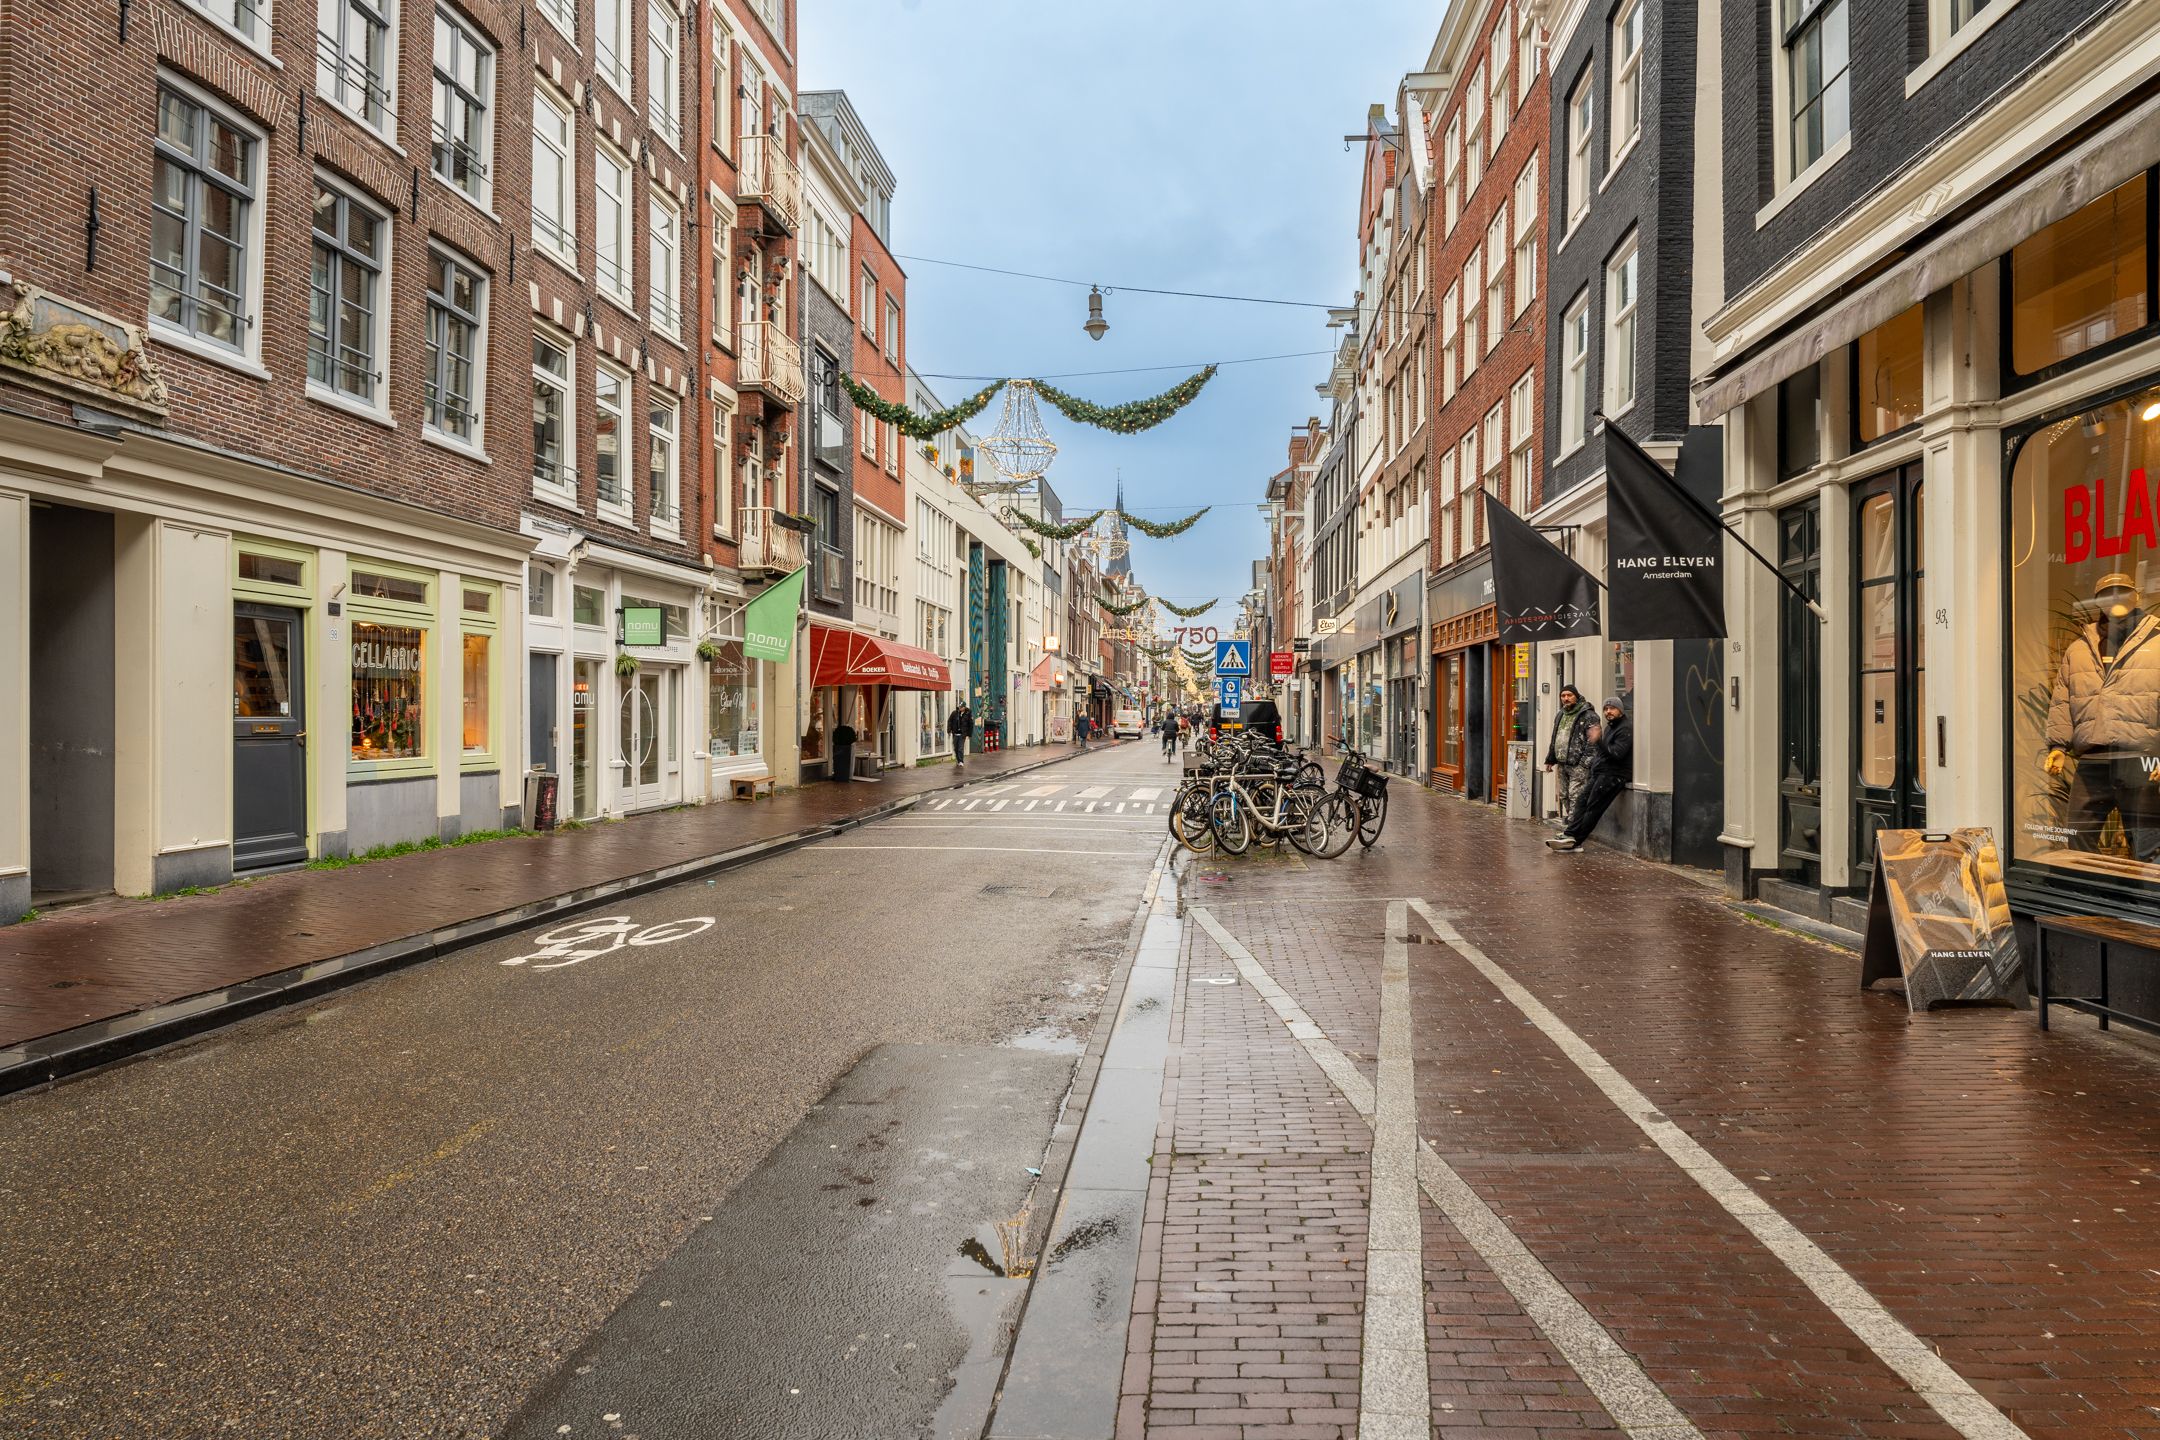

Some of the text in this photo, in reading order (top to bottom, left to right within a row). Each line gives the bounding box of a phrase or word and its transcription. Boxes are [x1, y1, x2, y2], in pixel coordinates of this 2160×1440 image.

[2064, 467, 2160, 565] BLA
[1617, 556, 1715, 568] HANG ELEVEN
[1642, 571, 1692, 580] Amsterdam
[627, 622, 658, 630] nomu
[1320, 619, 1336, 630] Etos
[746, 632, 787, 648] nomu
[1173, 626, 1218, 645] 750
[574, 691, 595, 705] omu
[2024, 823, 2078, 836] FOLLOW THE JOURNEY
